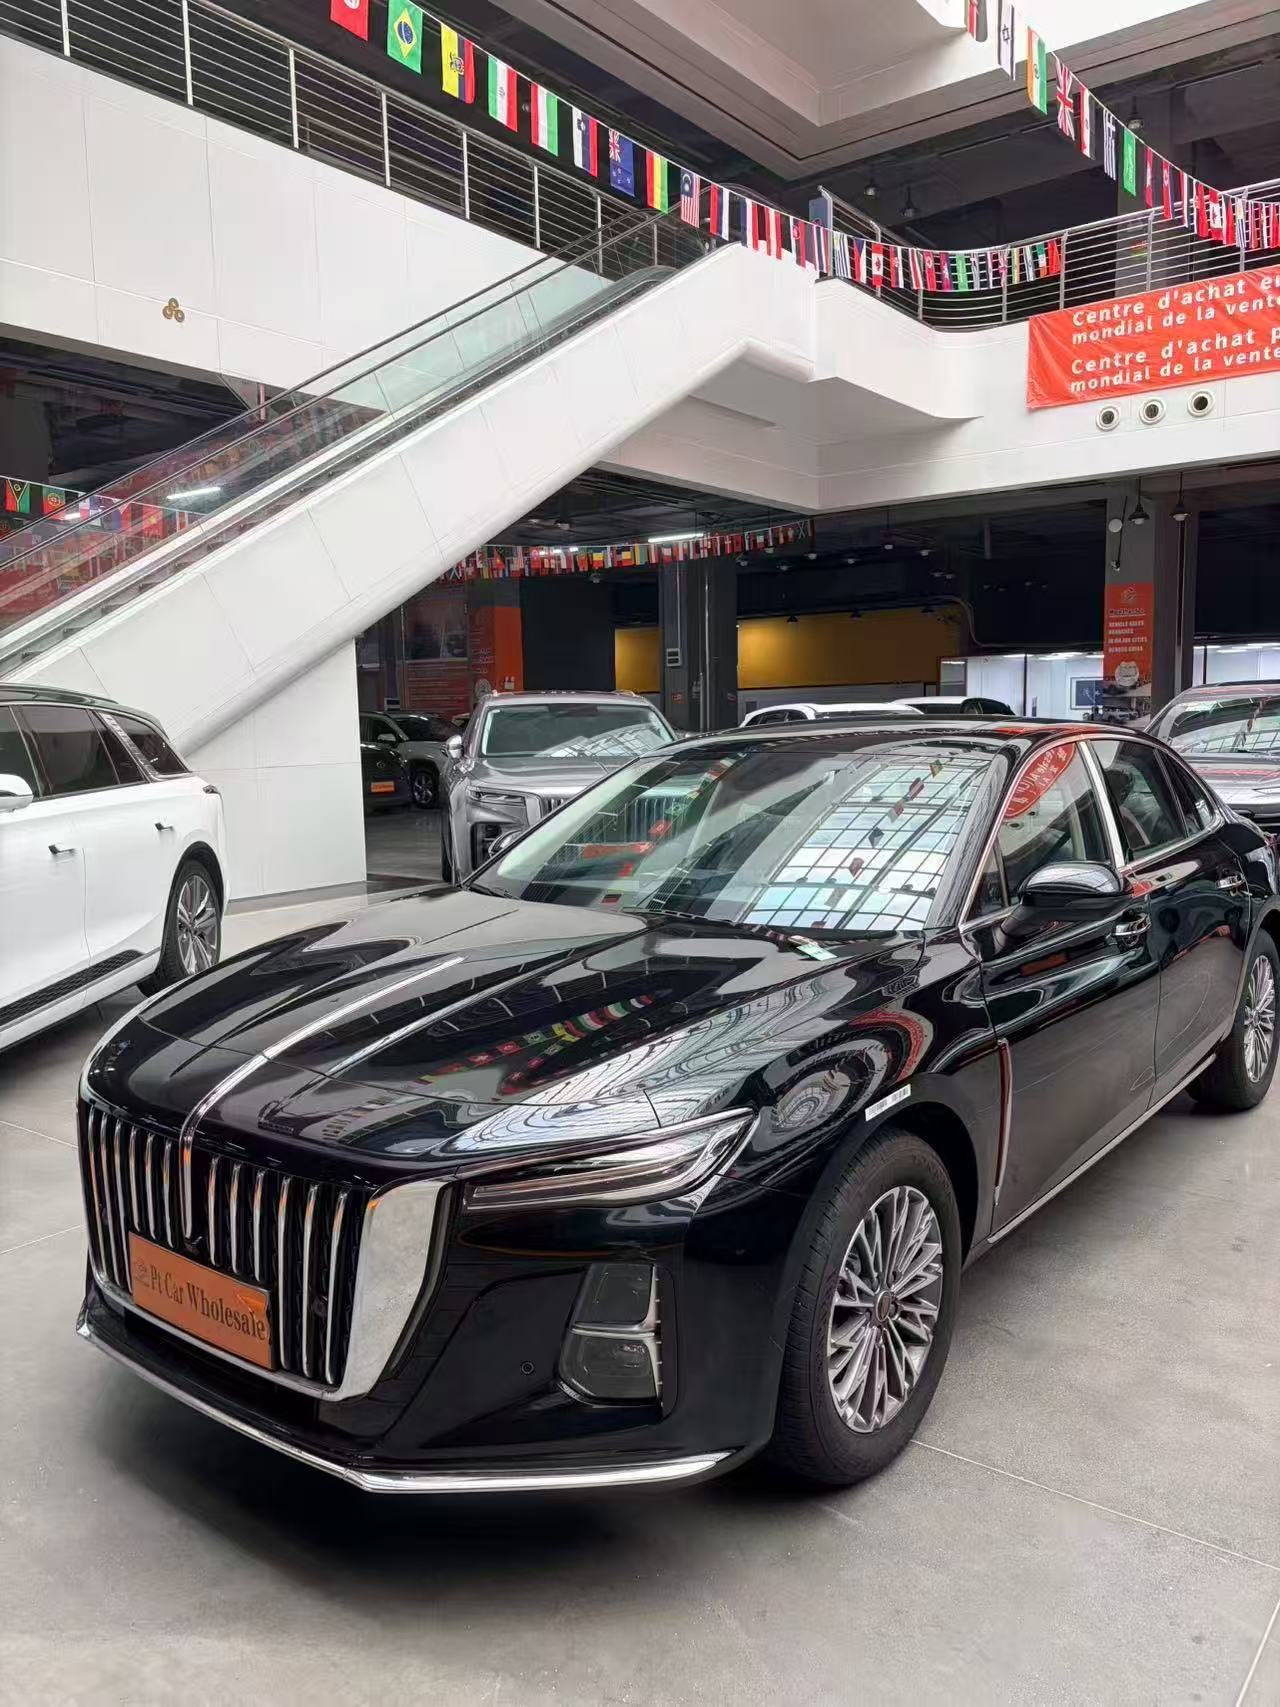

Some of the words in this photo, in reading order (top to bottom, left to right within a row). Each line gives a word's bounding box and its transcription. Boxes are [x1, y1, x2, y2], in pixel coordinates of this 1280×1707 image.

[1072, 301, 1145, 327] Centre
[1158, 279, 1247, 310] d'achat
[1072, 317, 1153, 345] mondial
[1162, 312, 1187, 328] de
[1197, 305, 1215, 321] la
[1070, 368, 1150, 393] mondial
[1160, 361, 1184, 377] de
[1194, 356, 1212, 372] la
[1071, 350, 1147, 375] Centre
[1161, 328, 1255, 359] d'achat
[165, 1271, 184, 1304] Car
[187, 1282, 265, 1341] Wholesale
